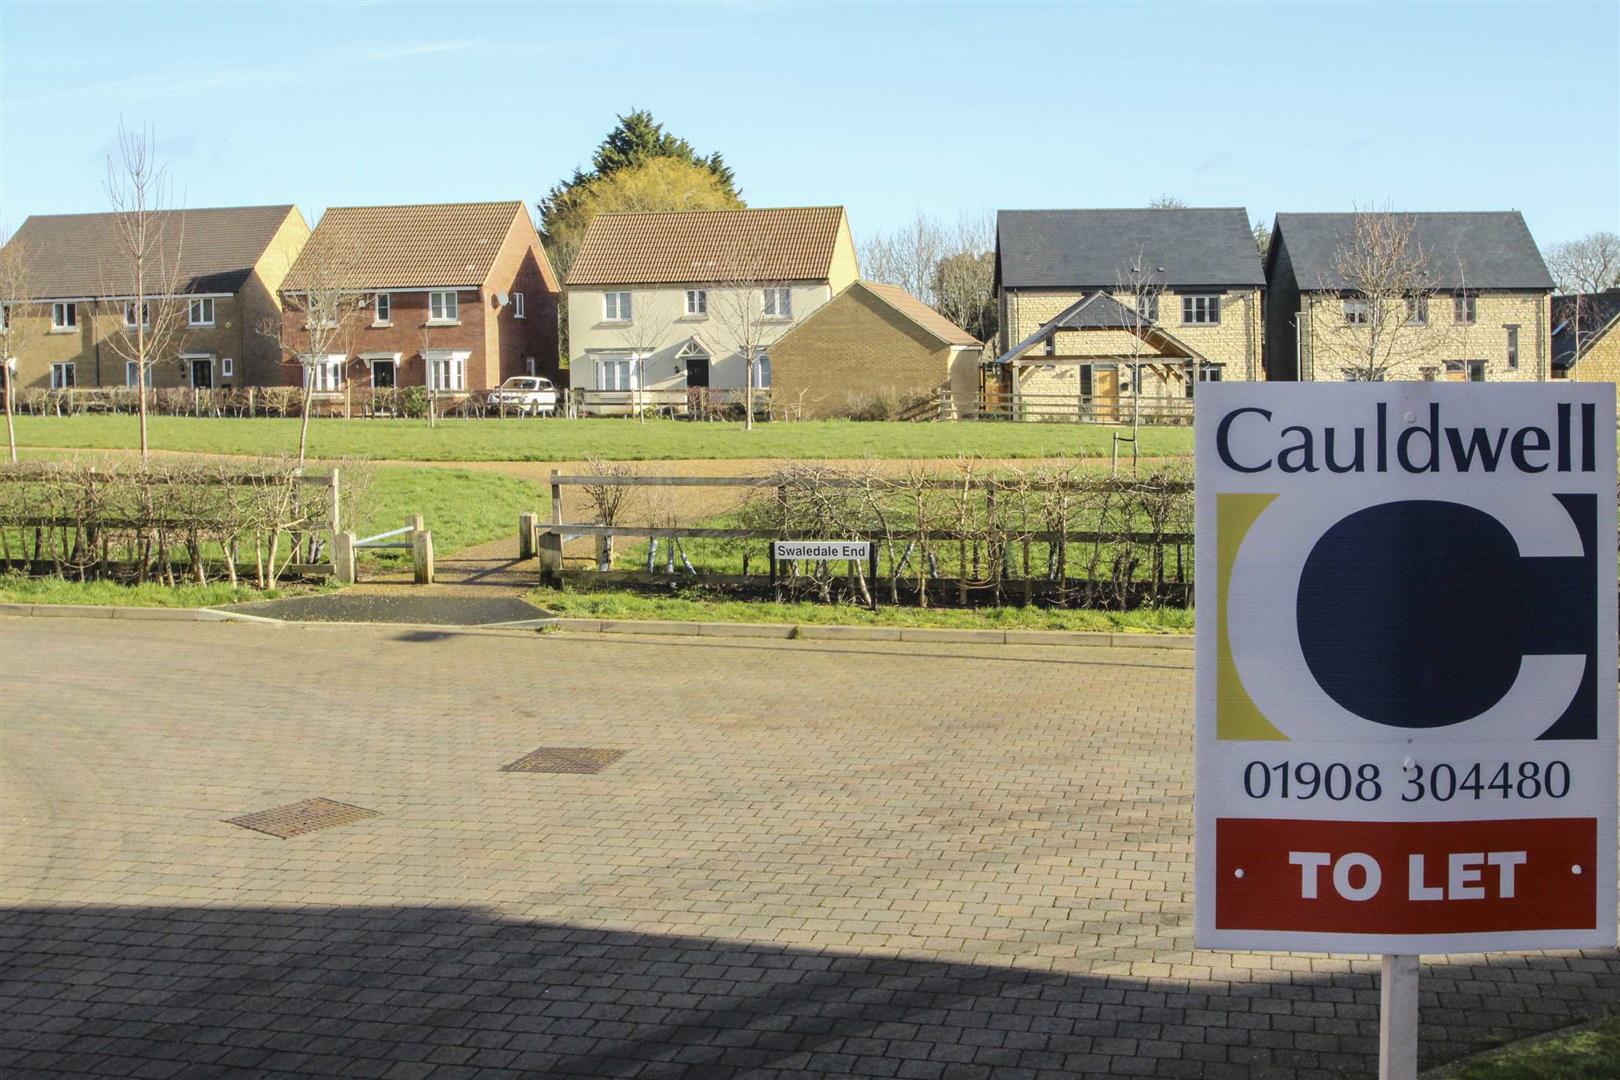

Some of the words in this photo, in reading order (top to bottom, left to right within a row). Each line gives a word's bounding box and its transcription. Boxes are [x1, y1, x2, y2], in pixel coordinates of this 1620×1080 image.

[1216, 402, 1596, 473] Cauldwell
[778, 545, 838, 556] Swaledale
[843, 546, 865, 556] End
[1243, 760, 1382, 801] 01908
[1401, 760, 1571, 802] 304480
[1289, 851, 1381, 901] TO
[1408, 850, 1527, 900] LET
